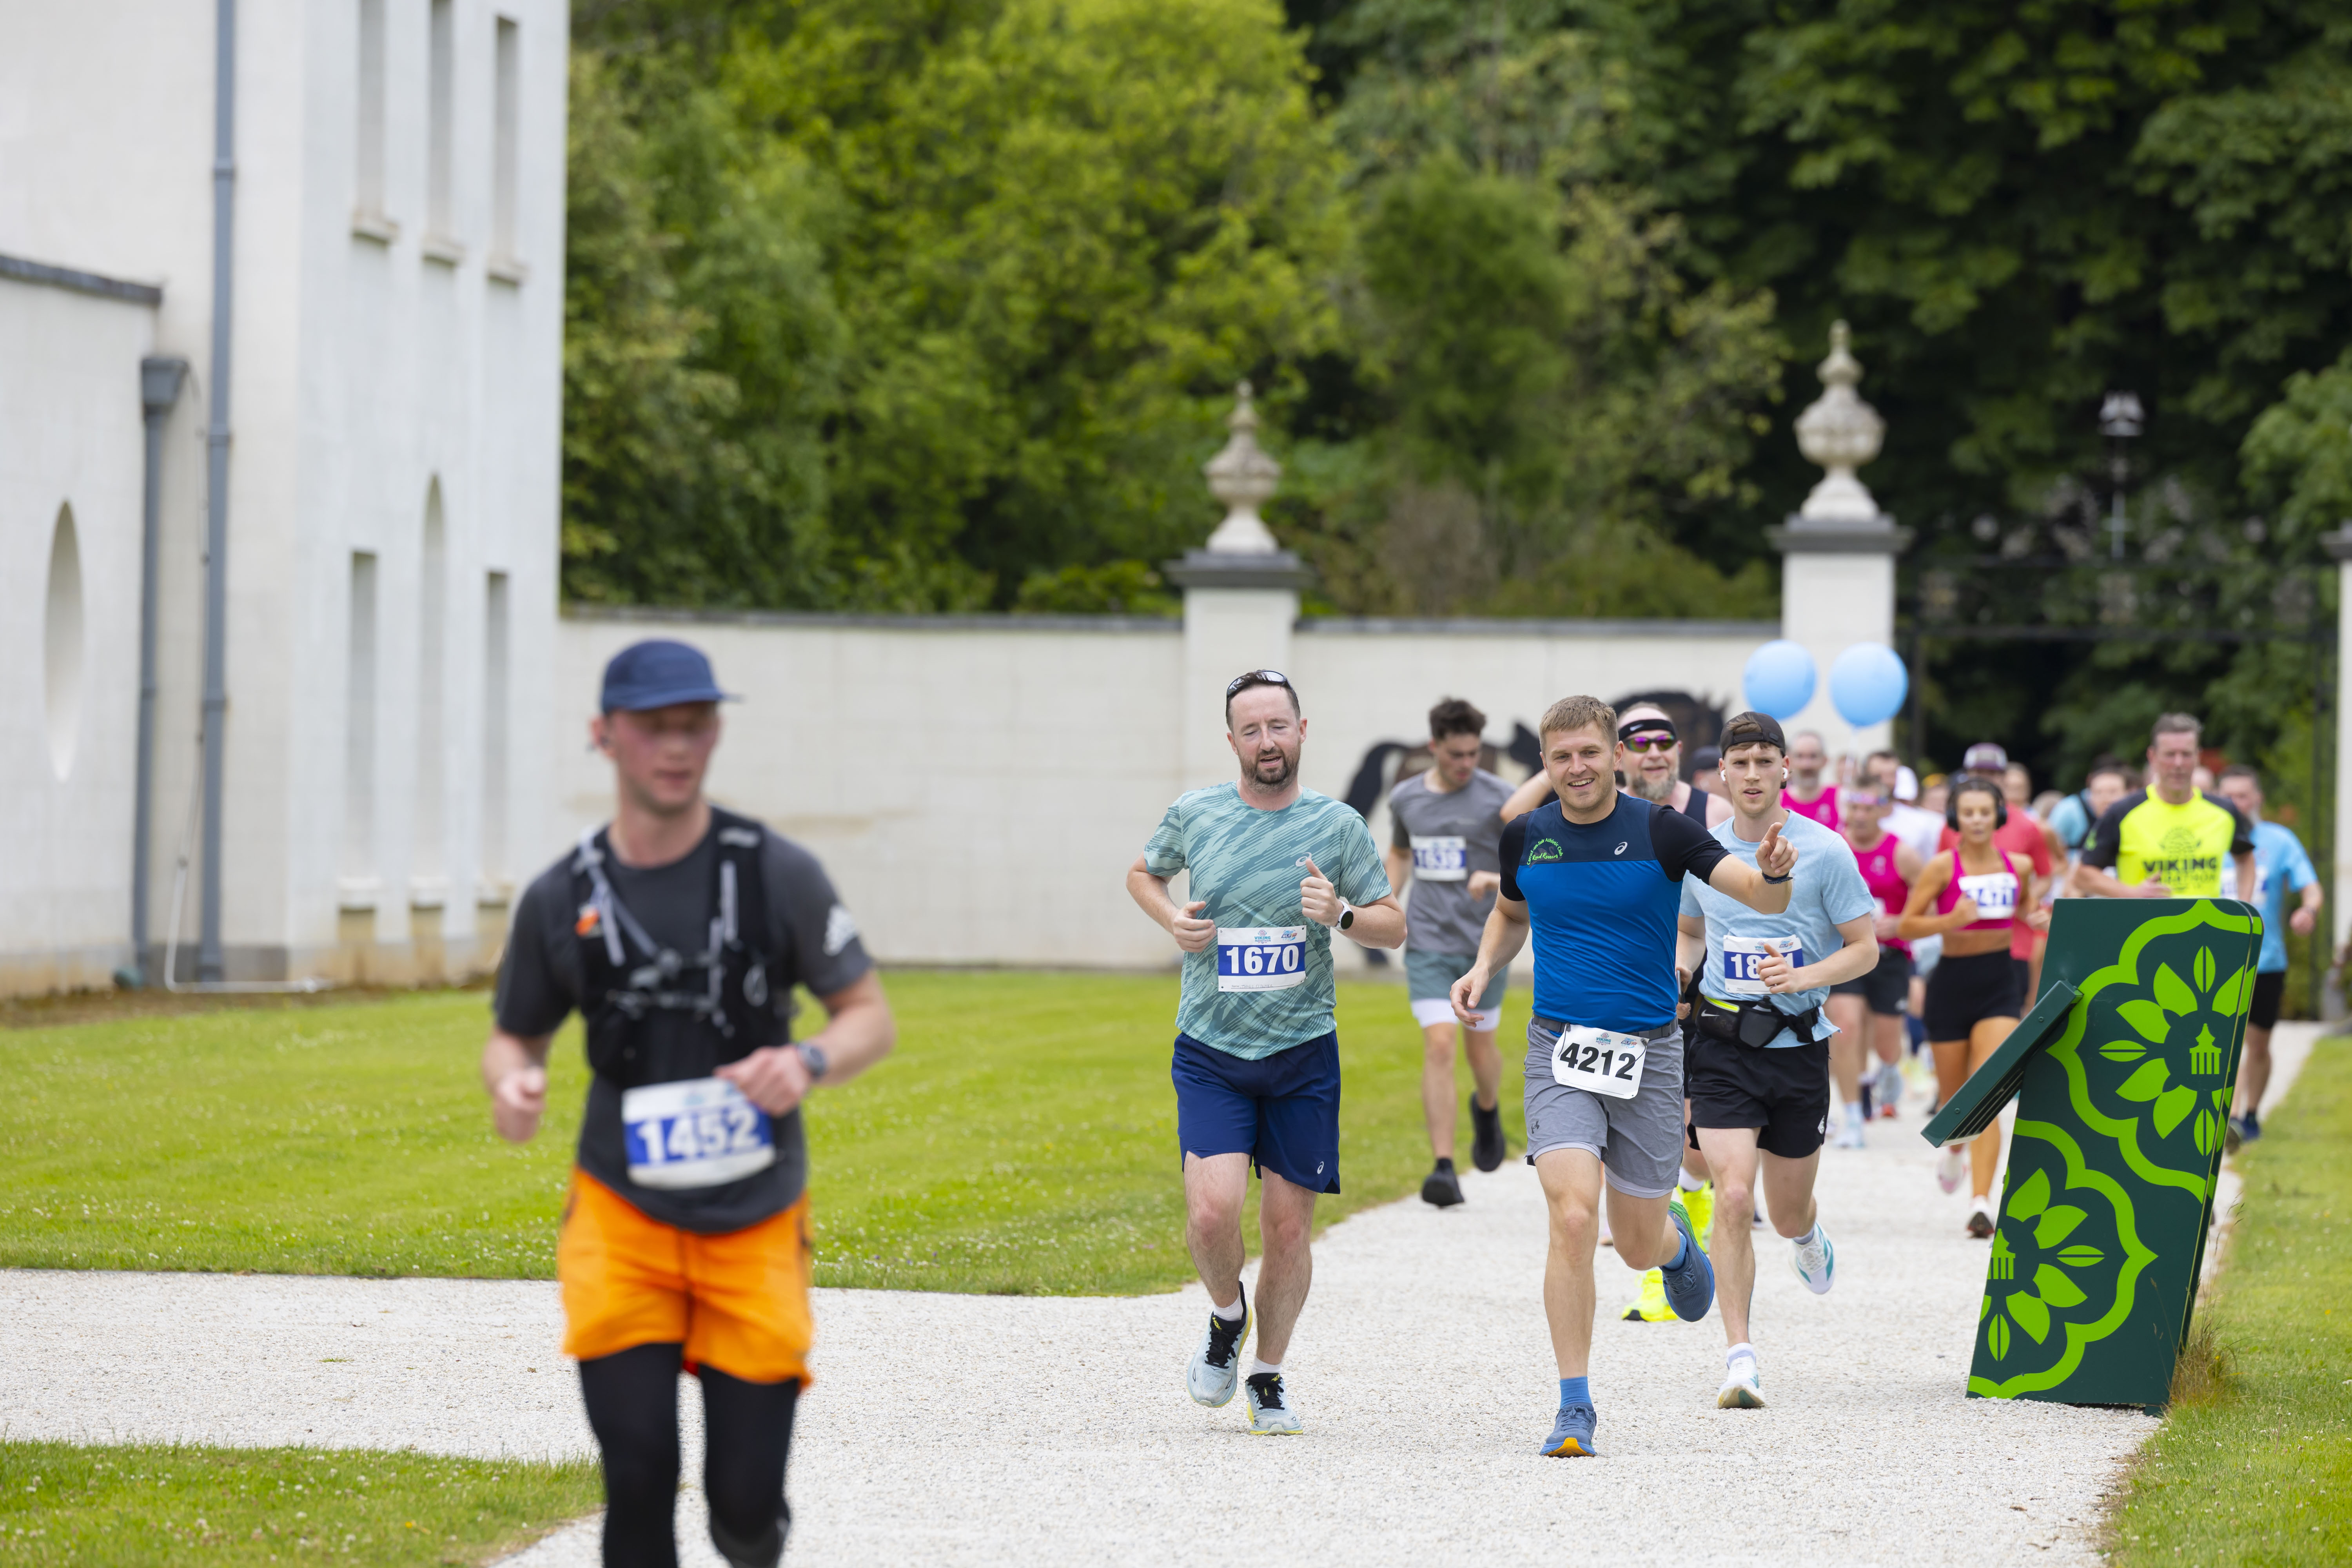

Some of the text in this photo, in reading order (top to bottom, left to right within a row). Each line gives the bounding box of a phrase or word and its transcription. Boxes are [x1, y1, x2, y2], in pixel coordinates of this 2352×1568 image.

[1545, 838, 1559, 847] Athletic
[2144, 857, 2216, 871] VIKING
[1227, 945, 1299, 974] 1670
[1731, 953, 1794, 979] 181
[1560, 1043, 1636, 1081] 4212
[637, 1107, 761, 1161] 1452
